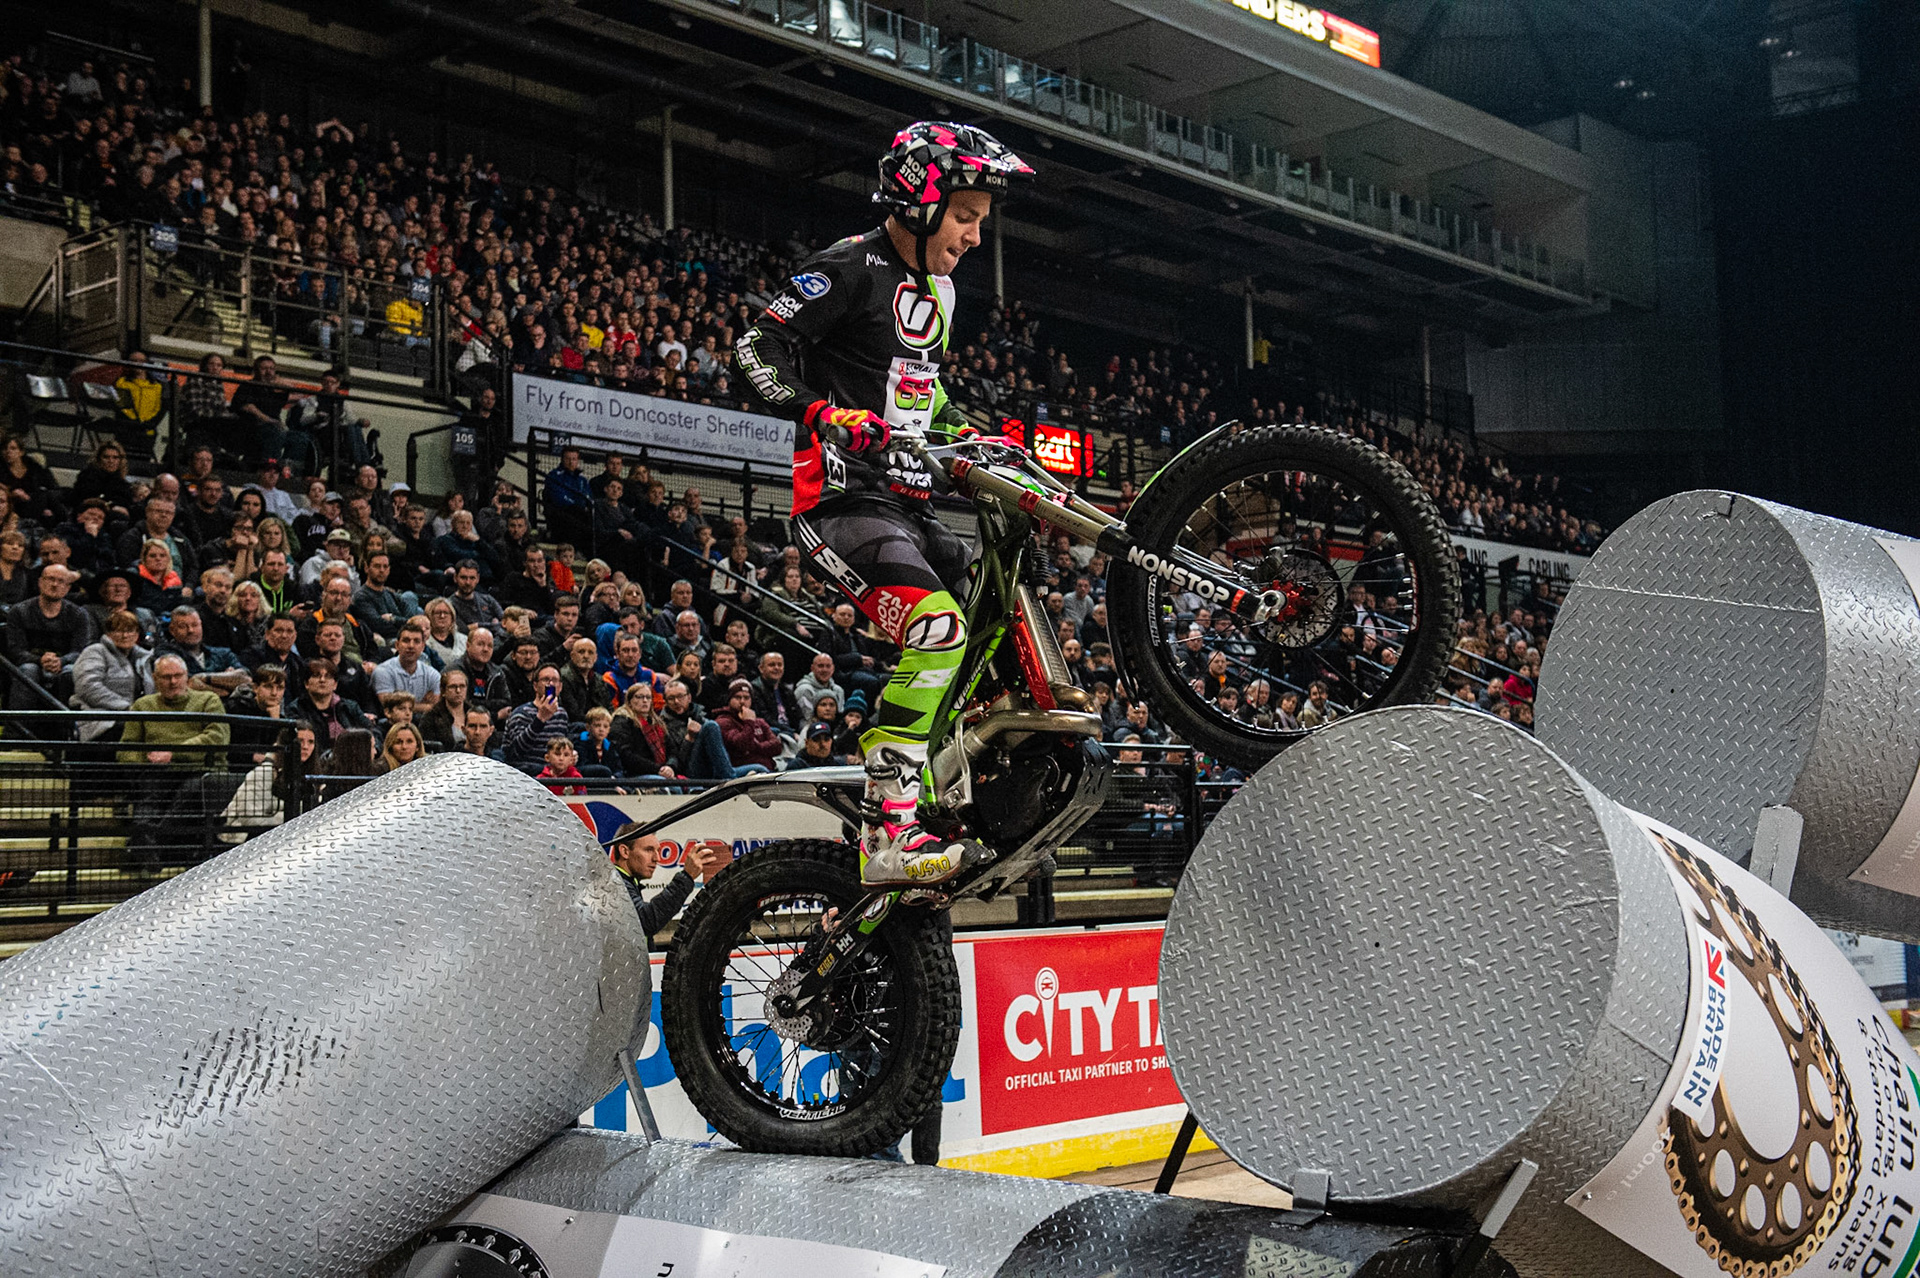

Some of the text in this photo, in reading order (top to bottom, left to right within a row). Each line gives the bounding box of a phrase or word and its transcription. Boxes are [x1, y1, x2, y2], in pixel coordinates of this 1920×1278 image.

[899, 163, 921, 186] STOP
[905, 154, 928, 180] NON
[412, 281, 430, 294] 204
[778, 292, 803, 313] NON
[768, 299, 795, 319] STOP
[526, 384, 553, 412] Fly
[558, 390, 603, 415] from
[609, 398, 701, 430] Doncaster
[706, 414, 779, 443] Sheffield
[455, 432, 474, 445] 105
[554, 435, 571, 446] 104
[1127, 545, 1231, 603] NONSTOP
[1528, 557, 1570, 578] CARLING
[877, 590, 893, 633] NON
[887, 596, 903, 638] STOP
[903, 855, 951, 880] BUSTO
[1004, 967, 1123, 1062] CITY
[1683, 984, 1717, 1100] BRITAIN
[1693, 991, 1726, 1107] MADE IN
[1005, 1070, 1056, 1090] OFFICIAL
[1058, 1066, 1083, 1083] TAXI
[1085, 1060, 1133, 1078] PARTNER
[1134, 1057, 1149, 1072] TO
[1872, 1014, 1918, 1172] chain
[1621, 1126, 1671, 1188] 400ml
[1828, 1018, 1886, 1271] & standard chains
[1842, 1035, 1898, 1272] for o-ring, x-ring
